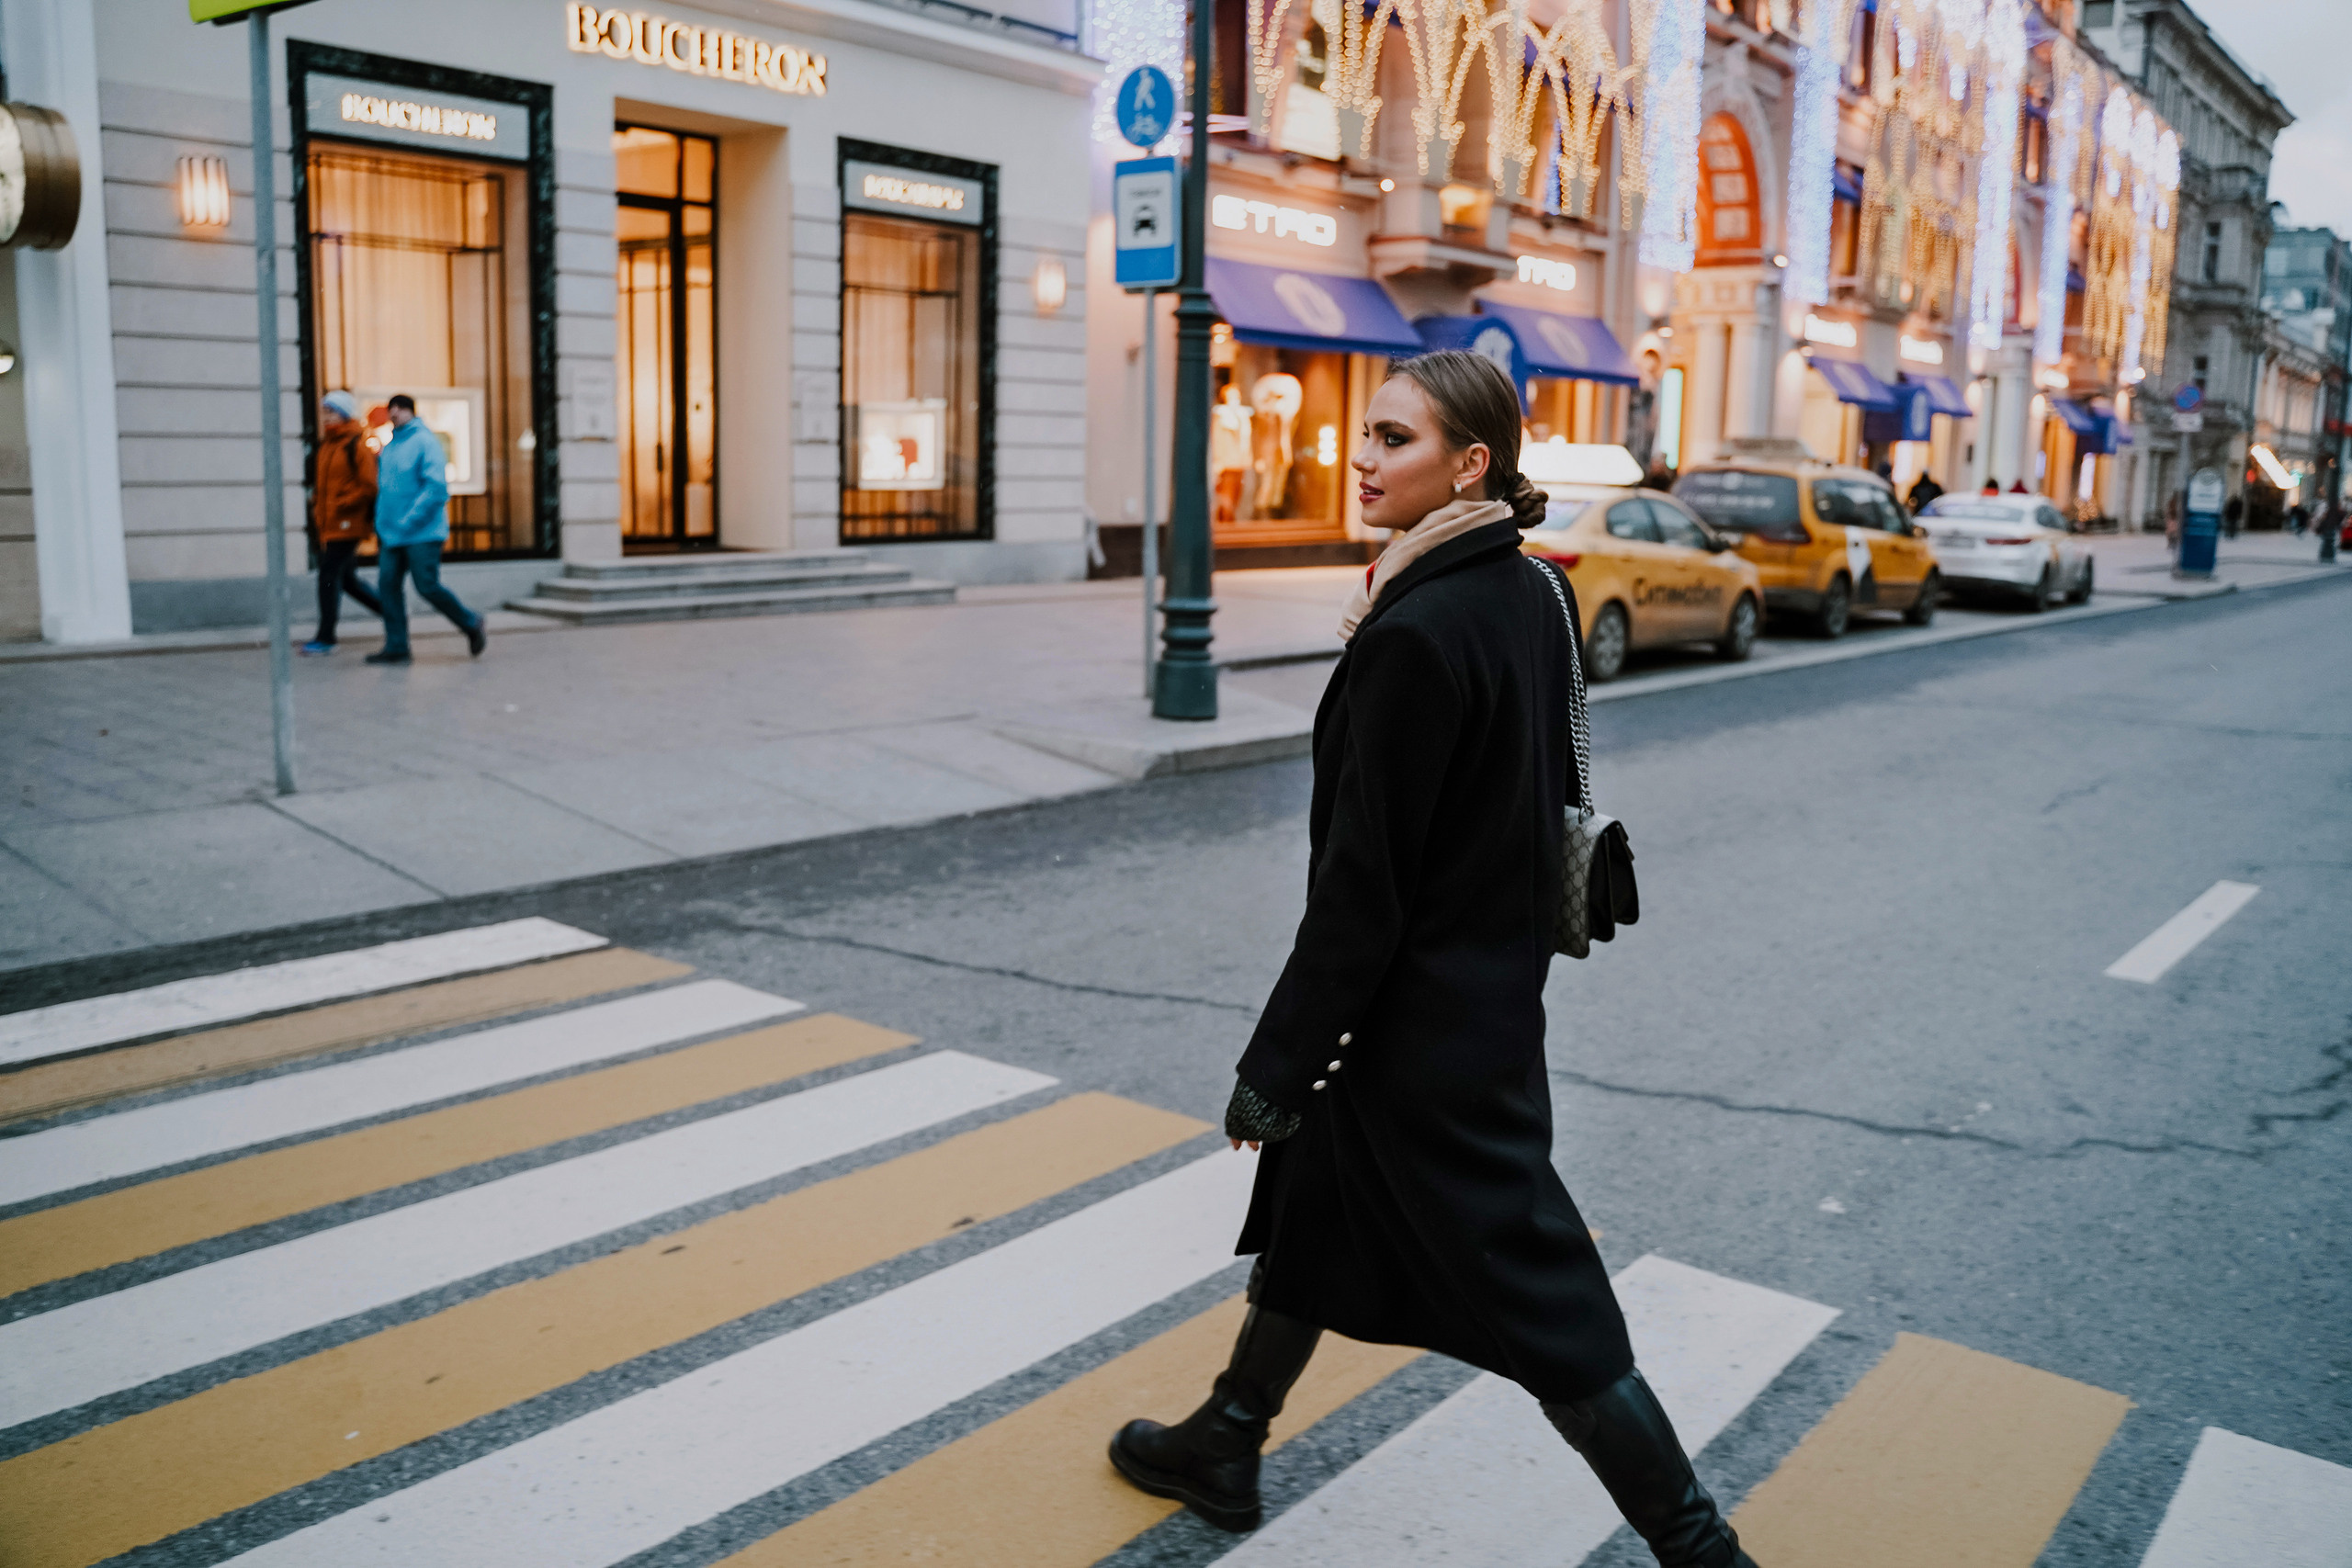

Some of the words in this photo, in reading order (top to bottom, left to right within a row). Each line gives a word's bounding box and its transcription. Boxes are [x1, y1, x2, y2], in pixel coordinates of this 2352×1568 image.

[567, 2, 827, 96] BOUCHERON
[1213, 195, 1337, 246] ETRO
[1516, 255, 1576, 291] TRO
